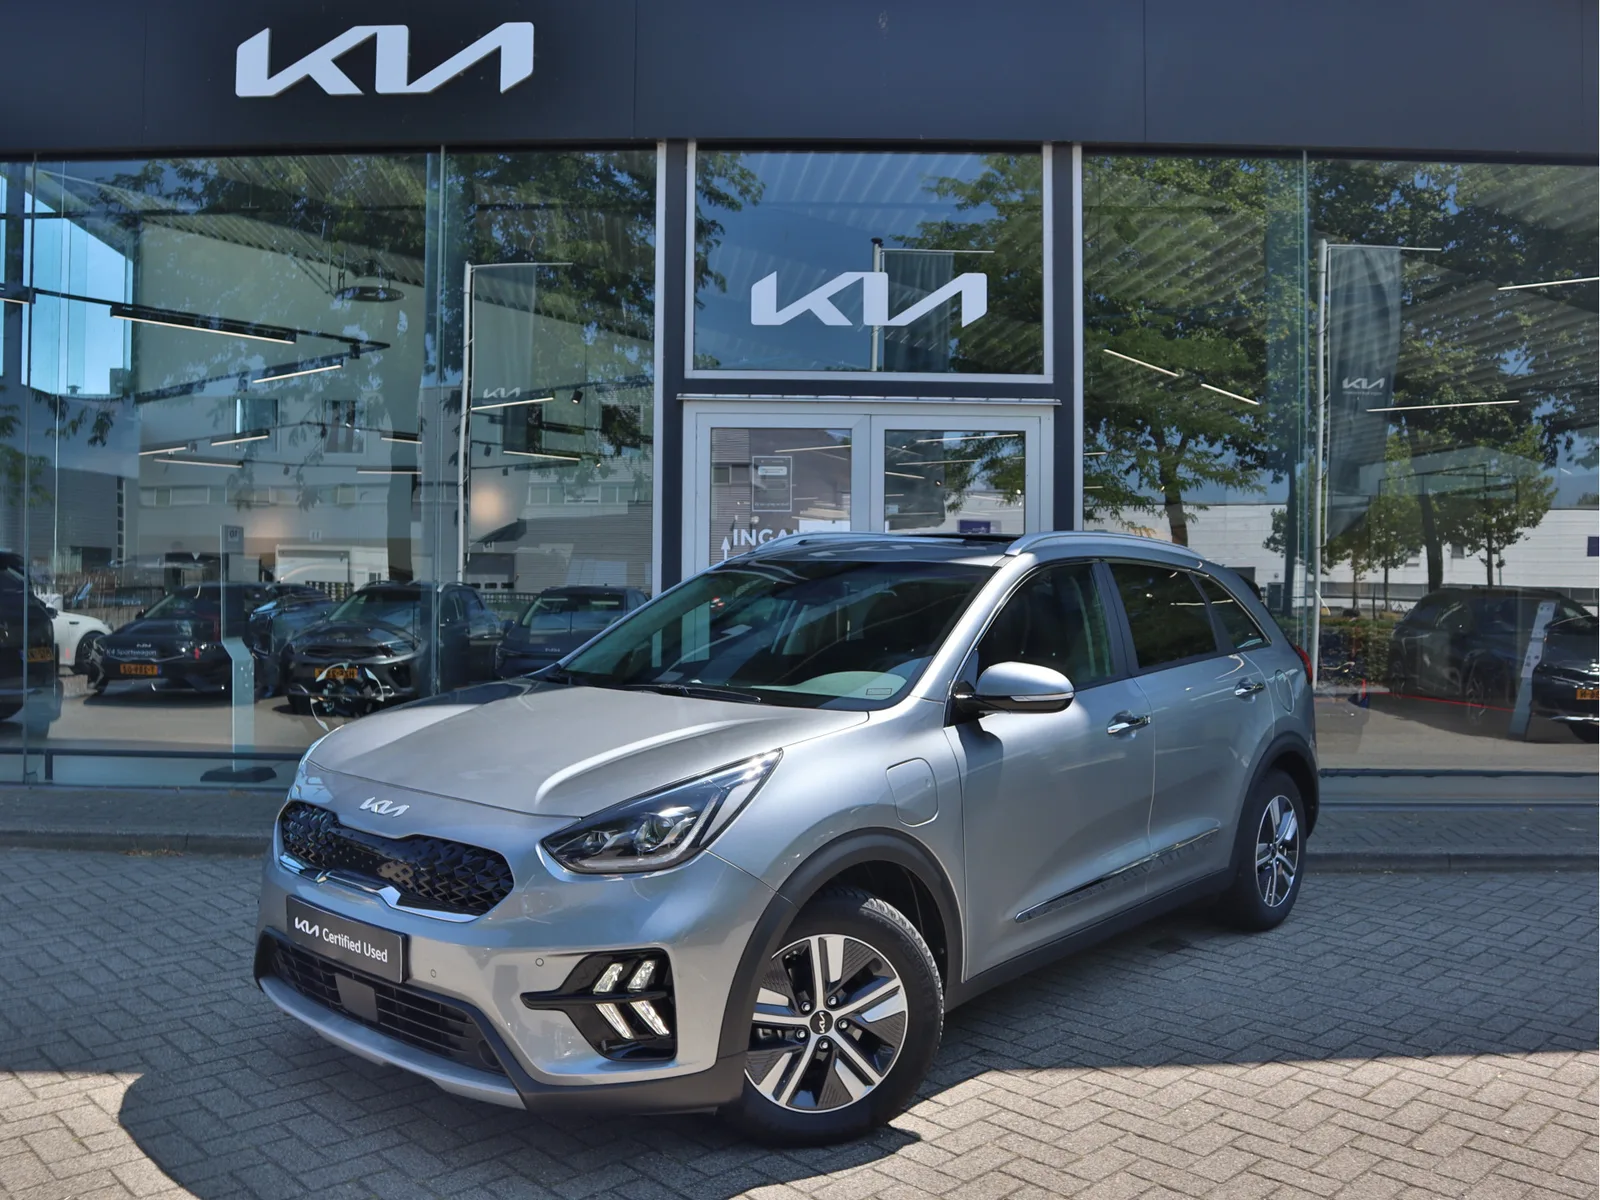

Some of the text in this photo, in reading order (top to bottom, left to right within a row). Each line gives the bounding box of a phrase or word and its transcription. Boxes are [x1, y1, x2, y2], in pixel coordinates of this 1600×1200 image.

[235, 21, 534, 98] KIA
[751, 271, 987, 328] KIA
[483, 387, 520, 398] KIA
[1342, 377, 1385, 389] KIA
[359, 796, 410, 818] KIA
[294, 916, 388, 963] KIA Certified Used
